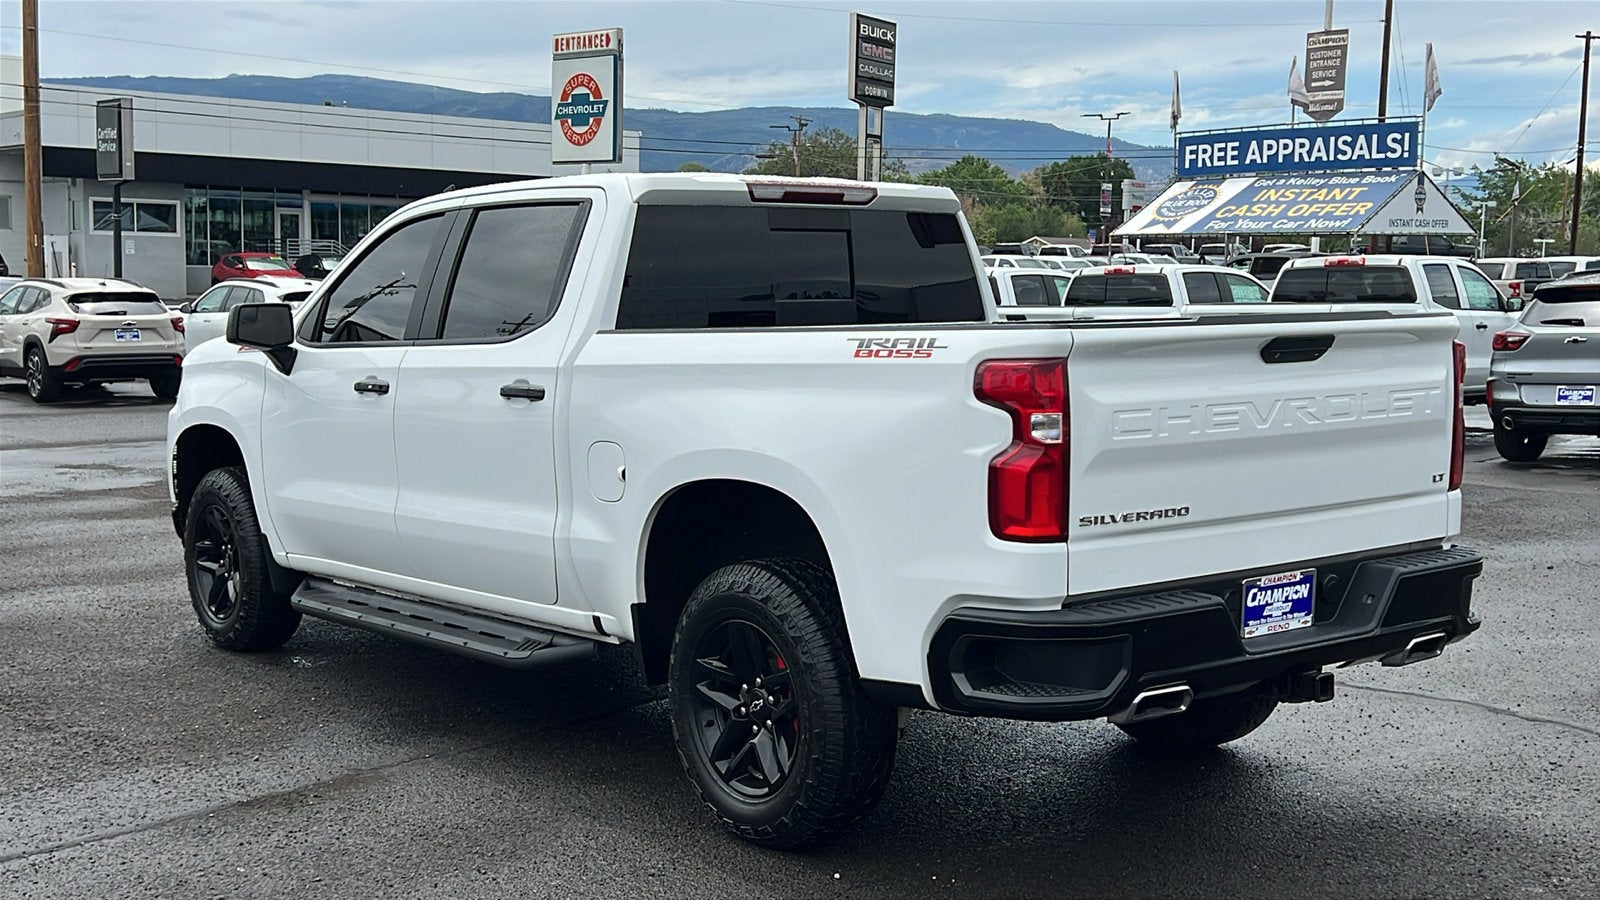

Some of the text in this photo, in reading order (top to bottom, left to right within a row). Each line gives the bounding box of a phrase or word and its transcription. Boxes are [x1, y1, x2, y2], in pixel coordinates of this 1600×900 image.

[860, 24, 895, 42] BUICK
[560, 33, 605, 52] ENTRANCE
[861, 42, 893, 61] GMC
[1310, 49, 1342, 60] CUSTOMER
[1309, 58, 1341, 69] ENTRANCE
[859, 63, 894, 78] CADILLAC
[1311, 69, 1337, 79] SERVICE
[565, 74, 597, 94] SUPER
[557, 104, 604, 115] CHEVROLET
[97, 127, 117, 139] Certified
[562, 121, 600, 144] SERVICE
[98, 140, 116, 152] Service
[1184, 132, 1411, 169] FREE APPRAISALS!
[1254, 179, 1273, 188] Get
[1286, 176, 1329, 188] Kelley
[1328, 176, 1358, 185] Blue
[1252, 187, 1369, 202] INSTANT
[1215, 204, 1287, 218] CASH
[1287, 202, 1374, 217] OFFER
[1203, 217, 1353, 230] For Your Car Now!
[1388, 218, 1449, 228] INSTANT CASH OFFER
[846, 337, 948, 349] TRAIL
[853, 348, 934, 359] BOSS
[1111, 386, 1441, 441] CHEVROLET
[1432, 472, 1446, 484] LT
[1079, 506, 1190, 528] SILVERADO
[1263, 573, 1298, 585] CHAMPION
[1246, 583, 1310, 608] CHAMPION
[1267, 622, 1290, 632] RENO
